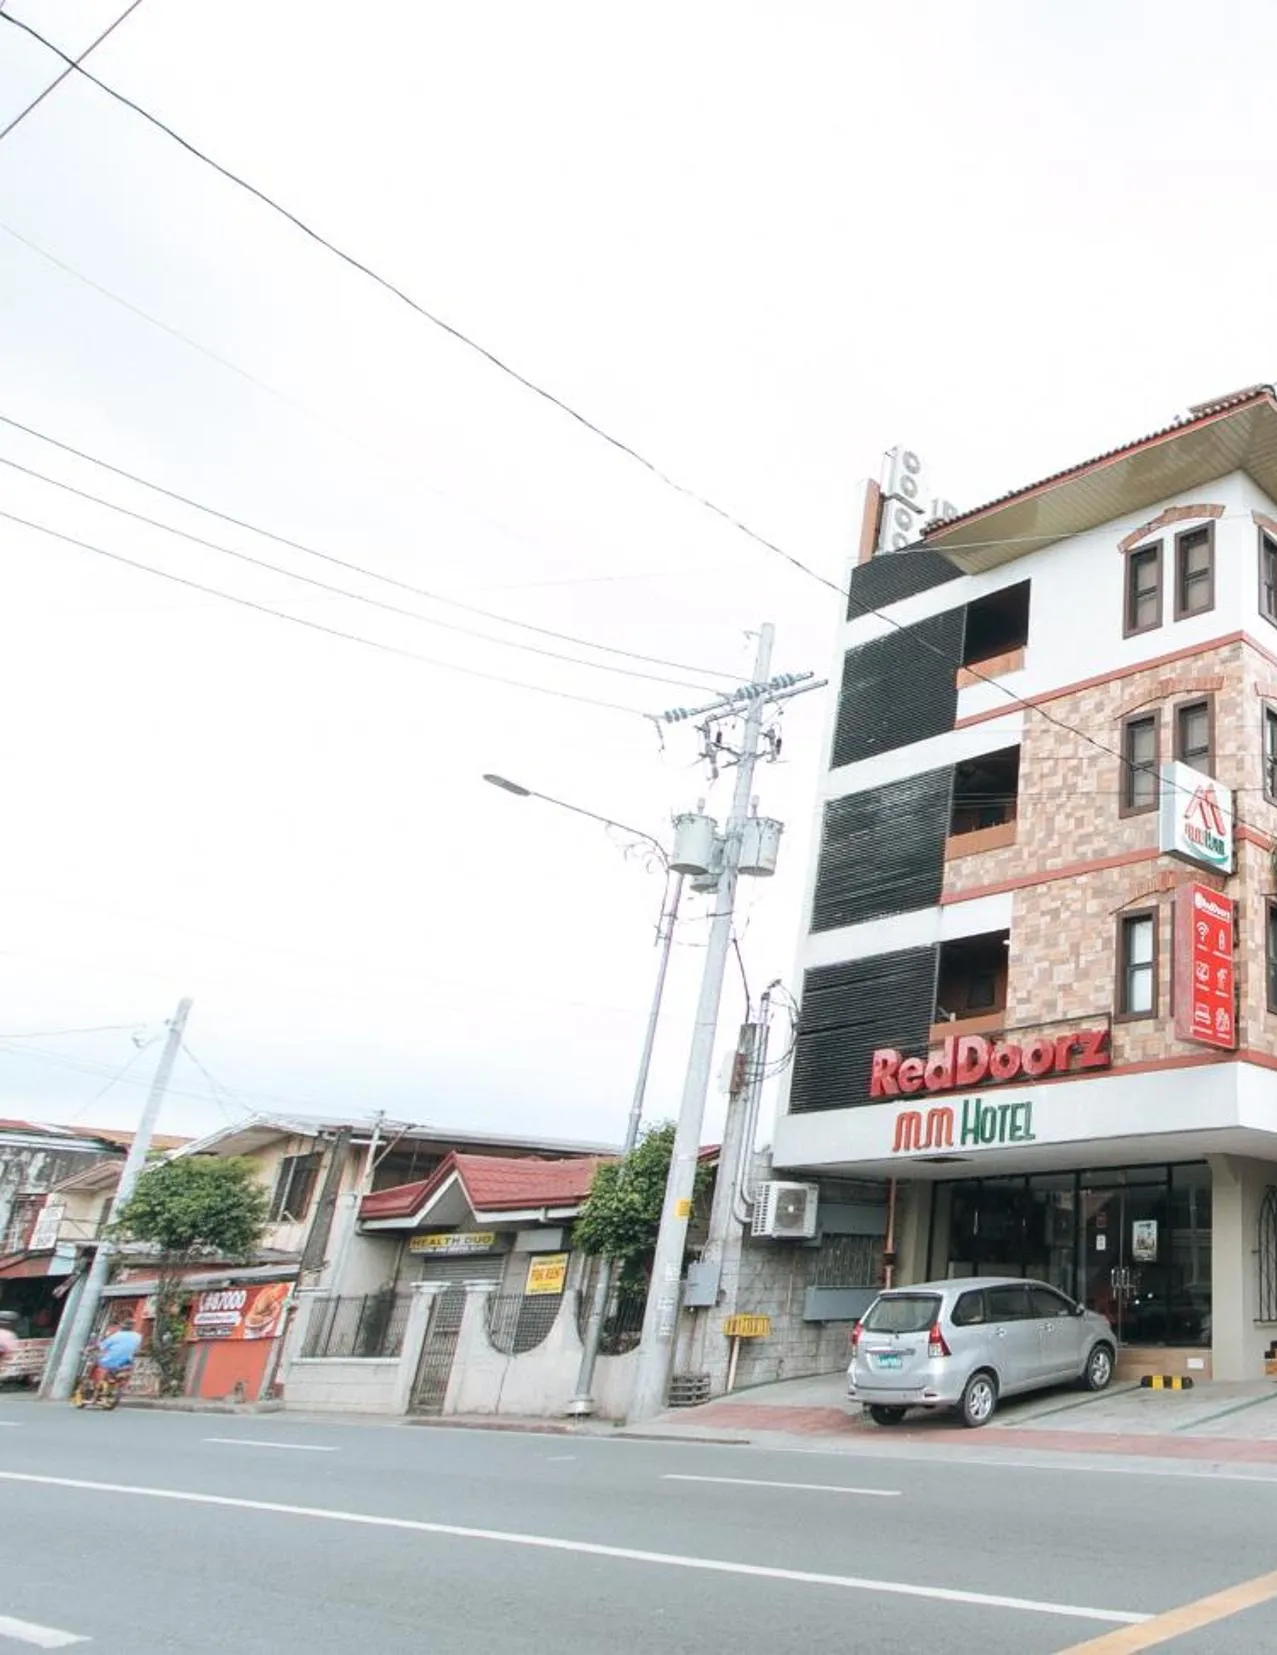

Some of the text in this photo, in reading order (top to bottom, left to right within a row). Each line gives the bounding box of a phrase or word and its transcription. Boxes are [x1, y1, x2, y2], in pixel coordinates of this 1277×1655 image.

[870, 1029, 1110, 1097] RedDoorz
[892, 1106, 954, 1152] MM
[412, 1235, 461, 1248] HEALTH
